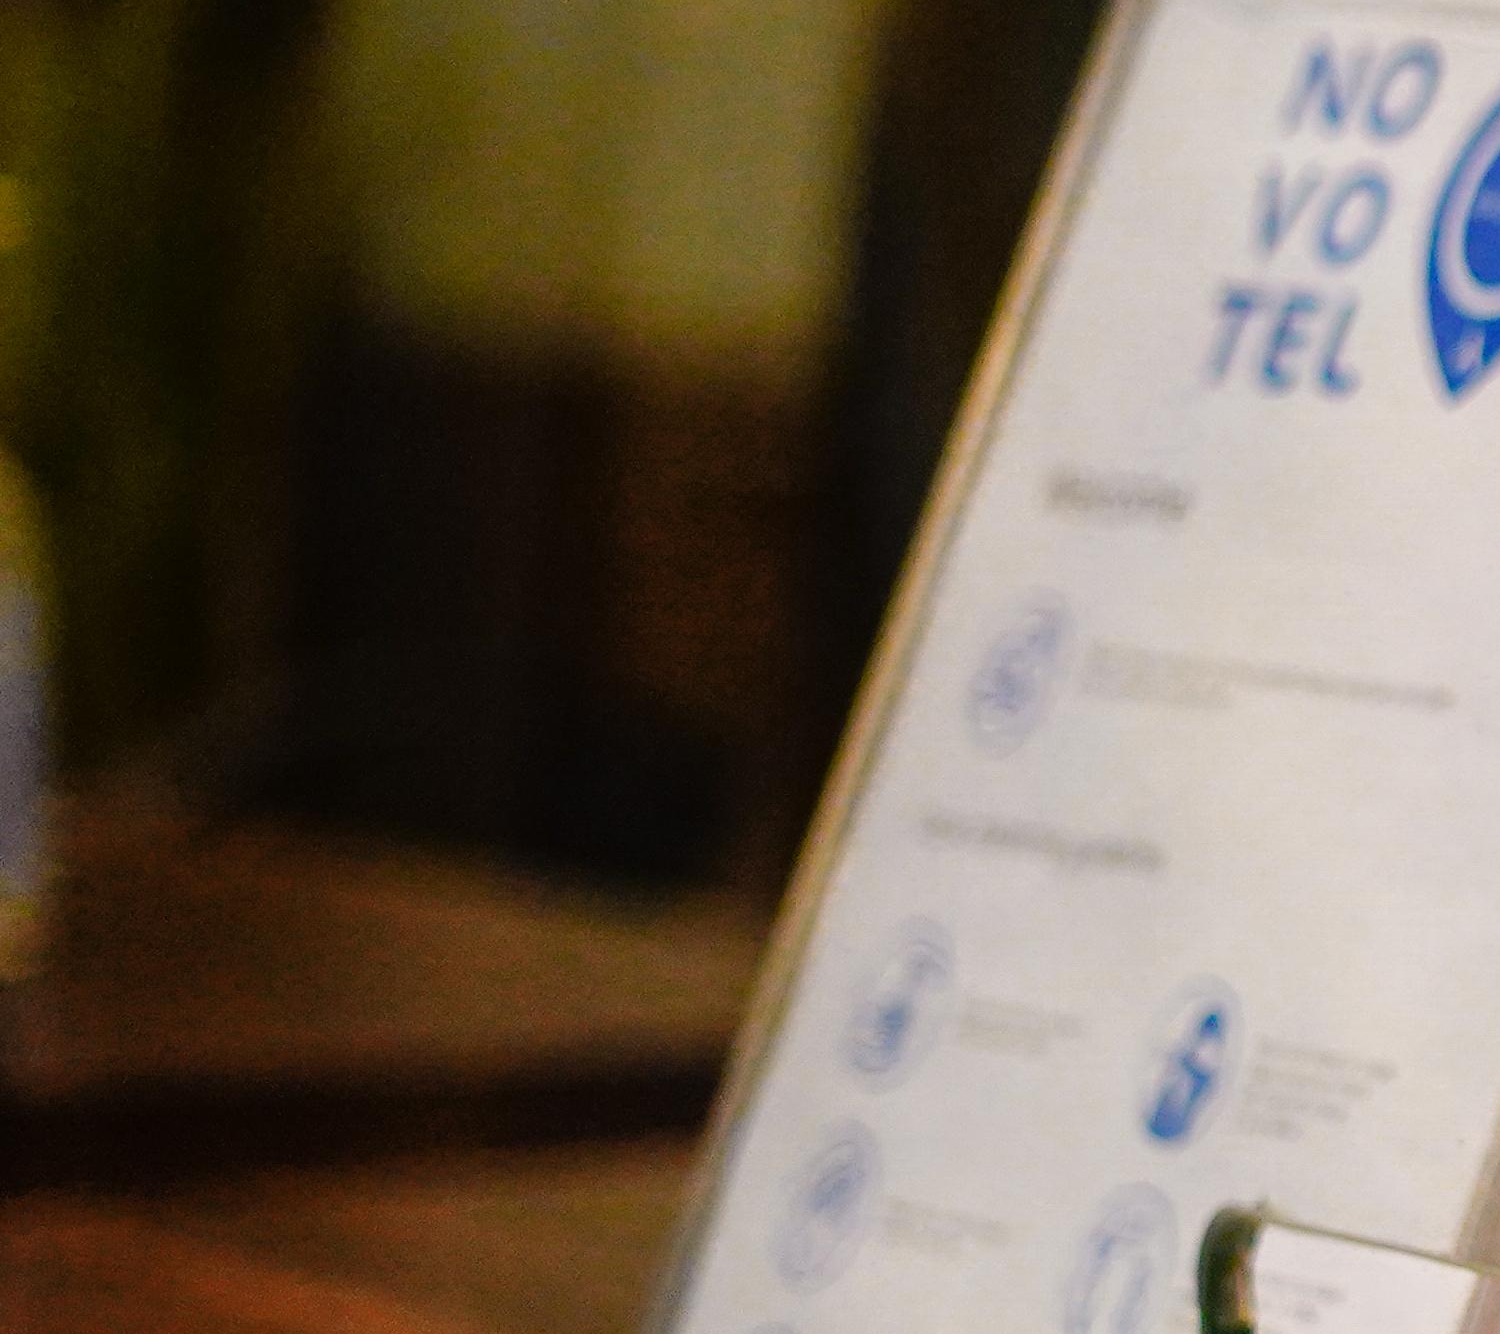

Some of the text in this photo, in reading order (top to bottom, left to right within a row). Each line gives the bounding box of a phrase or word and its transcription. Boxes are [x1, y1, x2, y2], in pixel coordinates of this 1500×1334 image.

[1282, 40, 1441, 139] NO
[1253, 160, 1391, 266] VO
[1206, 283, 1360, 391] TEL
